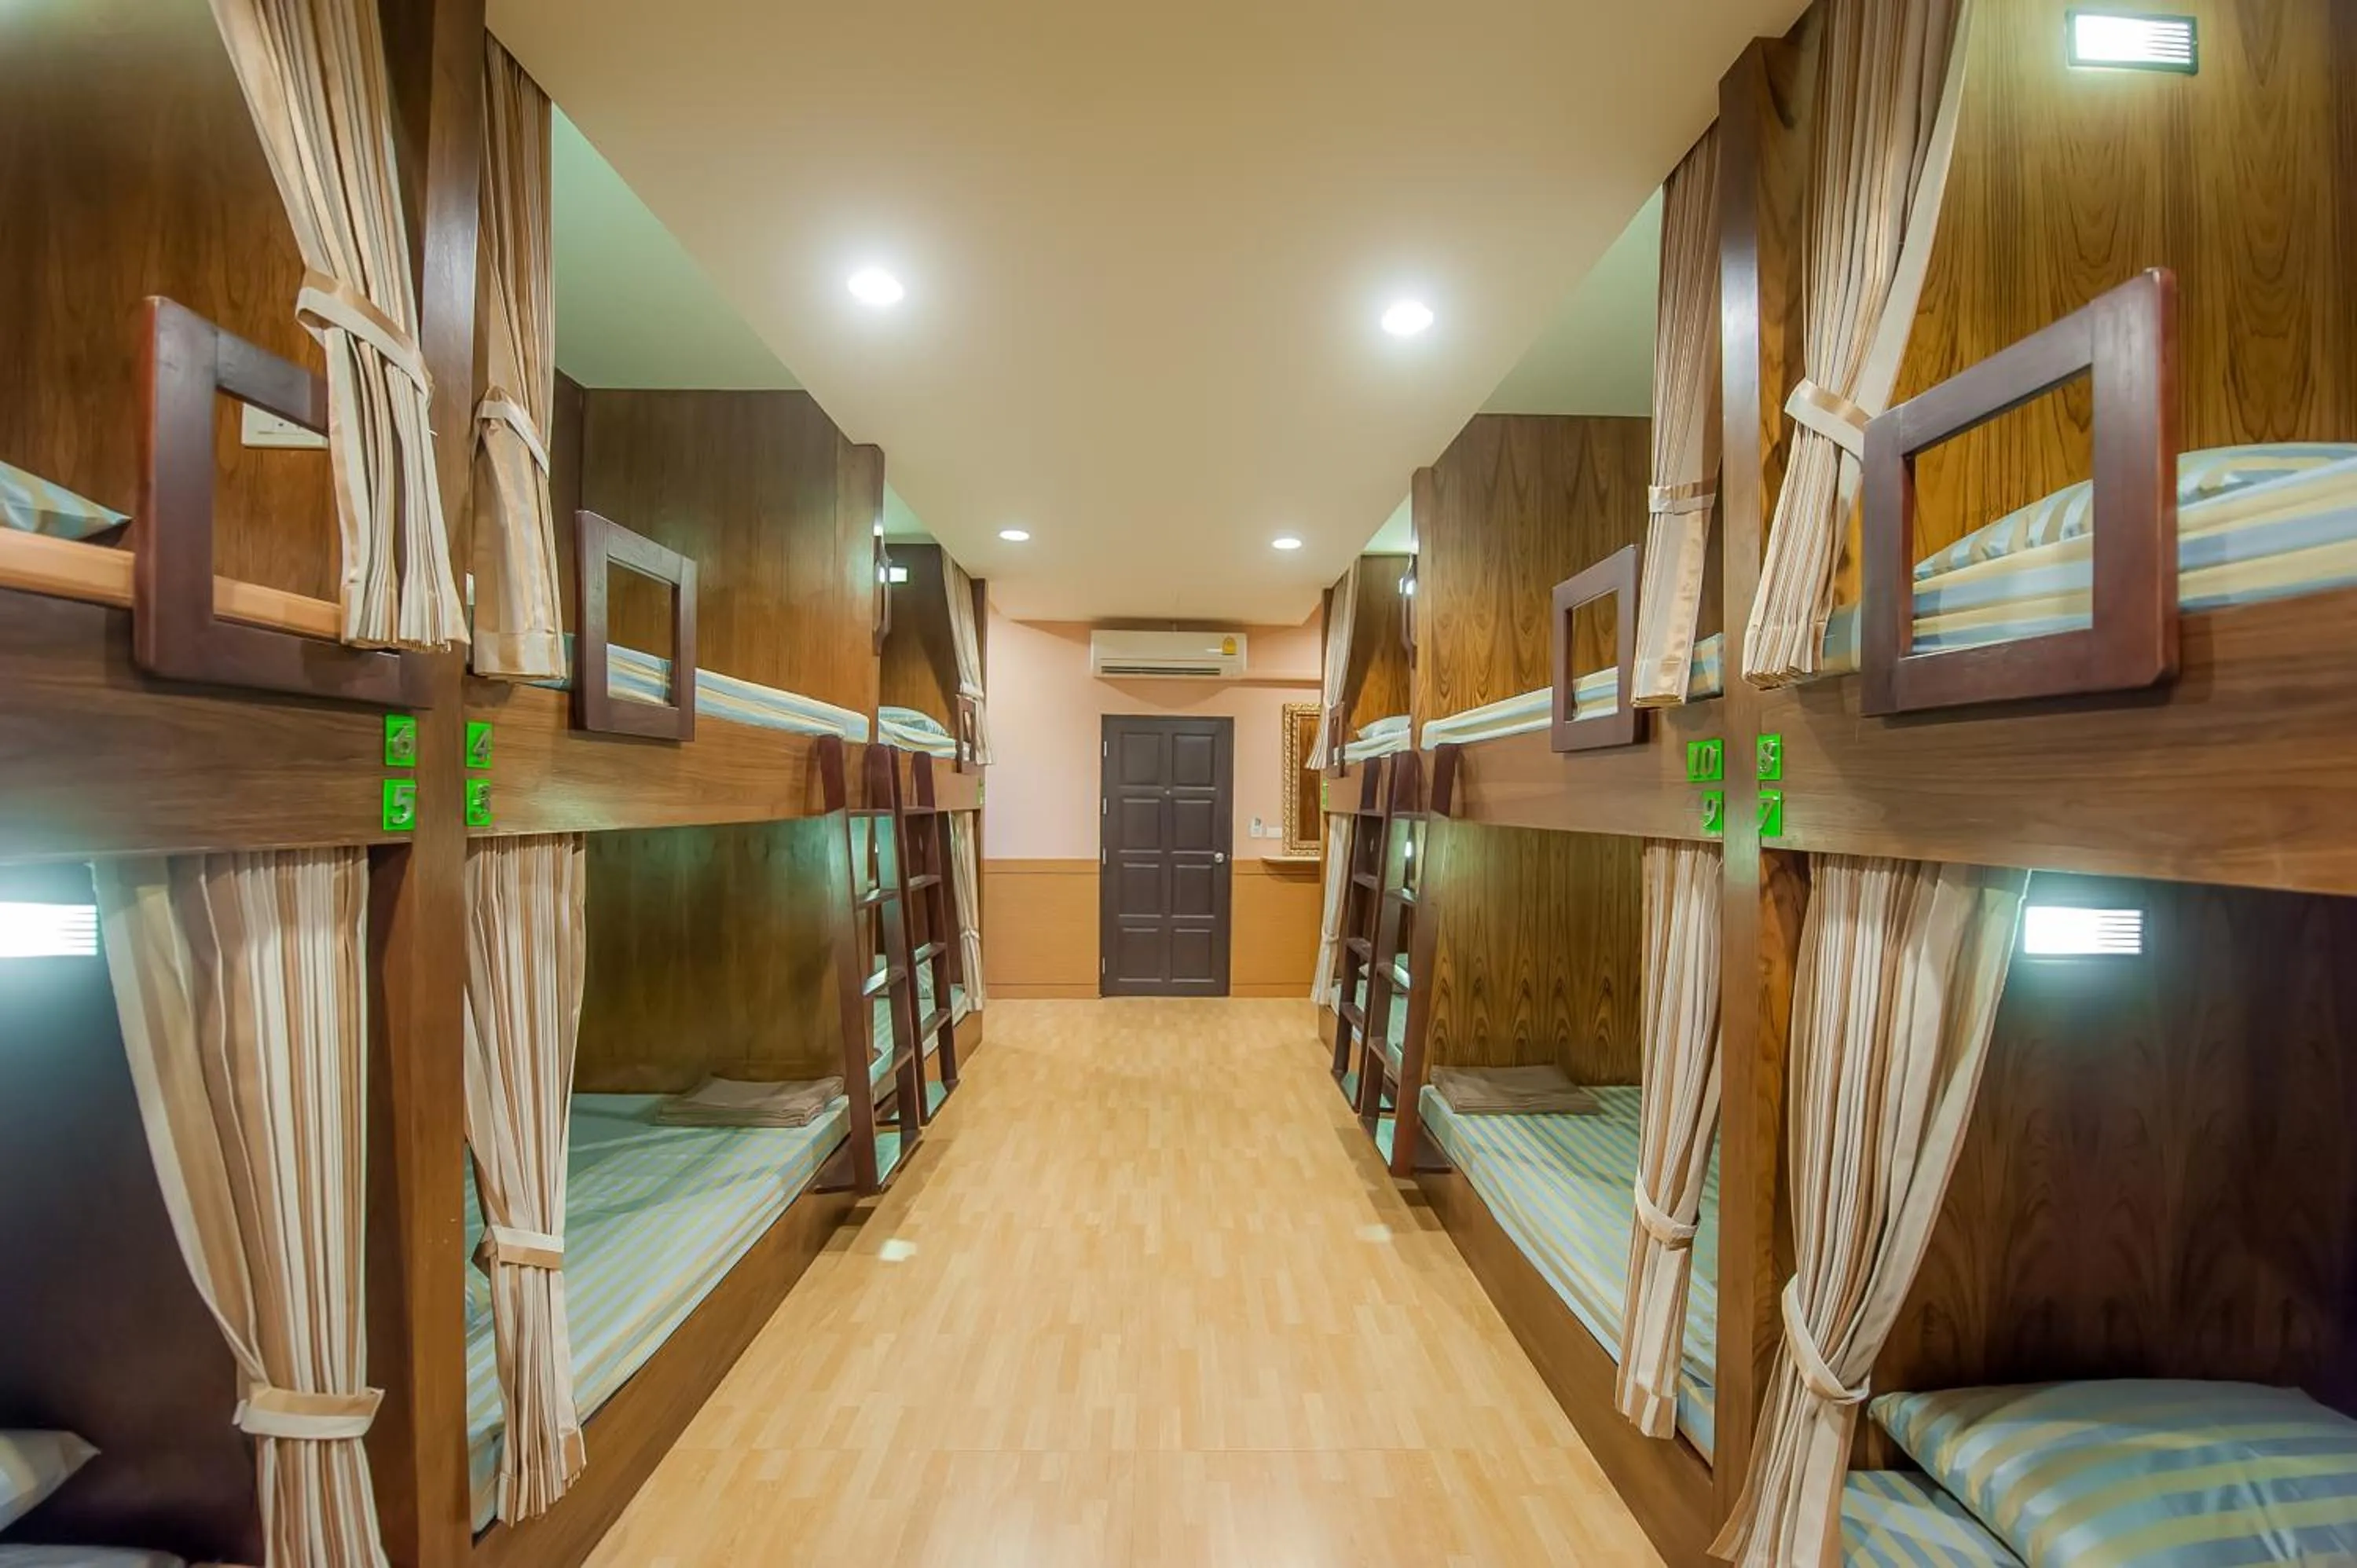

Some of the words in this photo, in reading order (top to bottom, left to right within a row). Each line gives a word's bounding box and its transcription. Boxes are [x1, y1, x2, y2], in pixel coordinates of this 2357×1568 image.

[390, 723, 415, 758] 6
[473, 729, 491, 762] 4
[1693, 746, 1718, 778] 10
[1761, 740, 1777, 775] 8
[390, 785, 417, 824] 5
[1703, 797, 1717, 828] 9
[1757, 797, 1779, 830] 7
